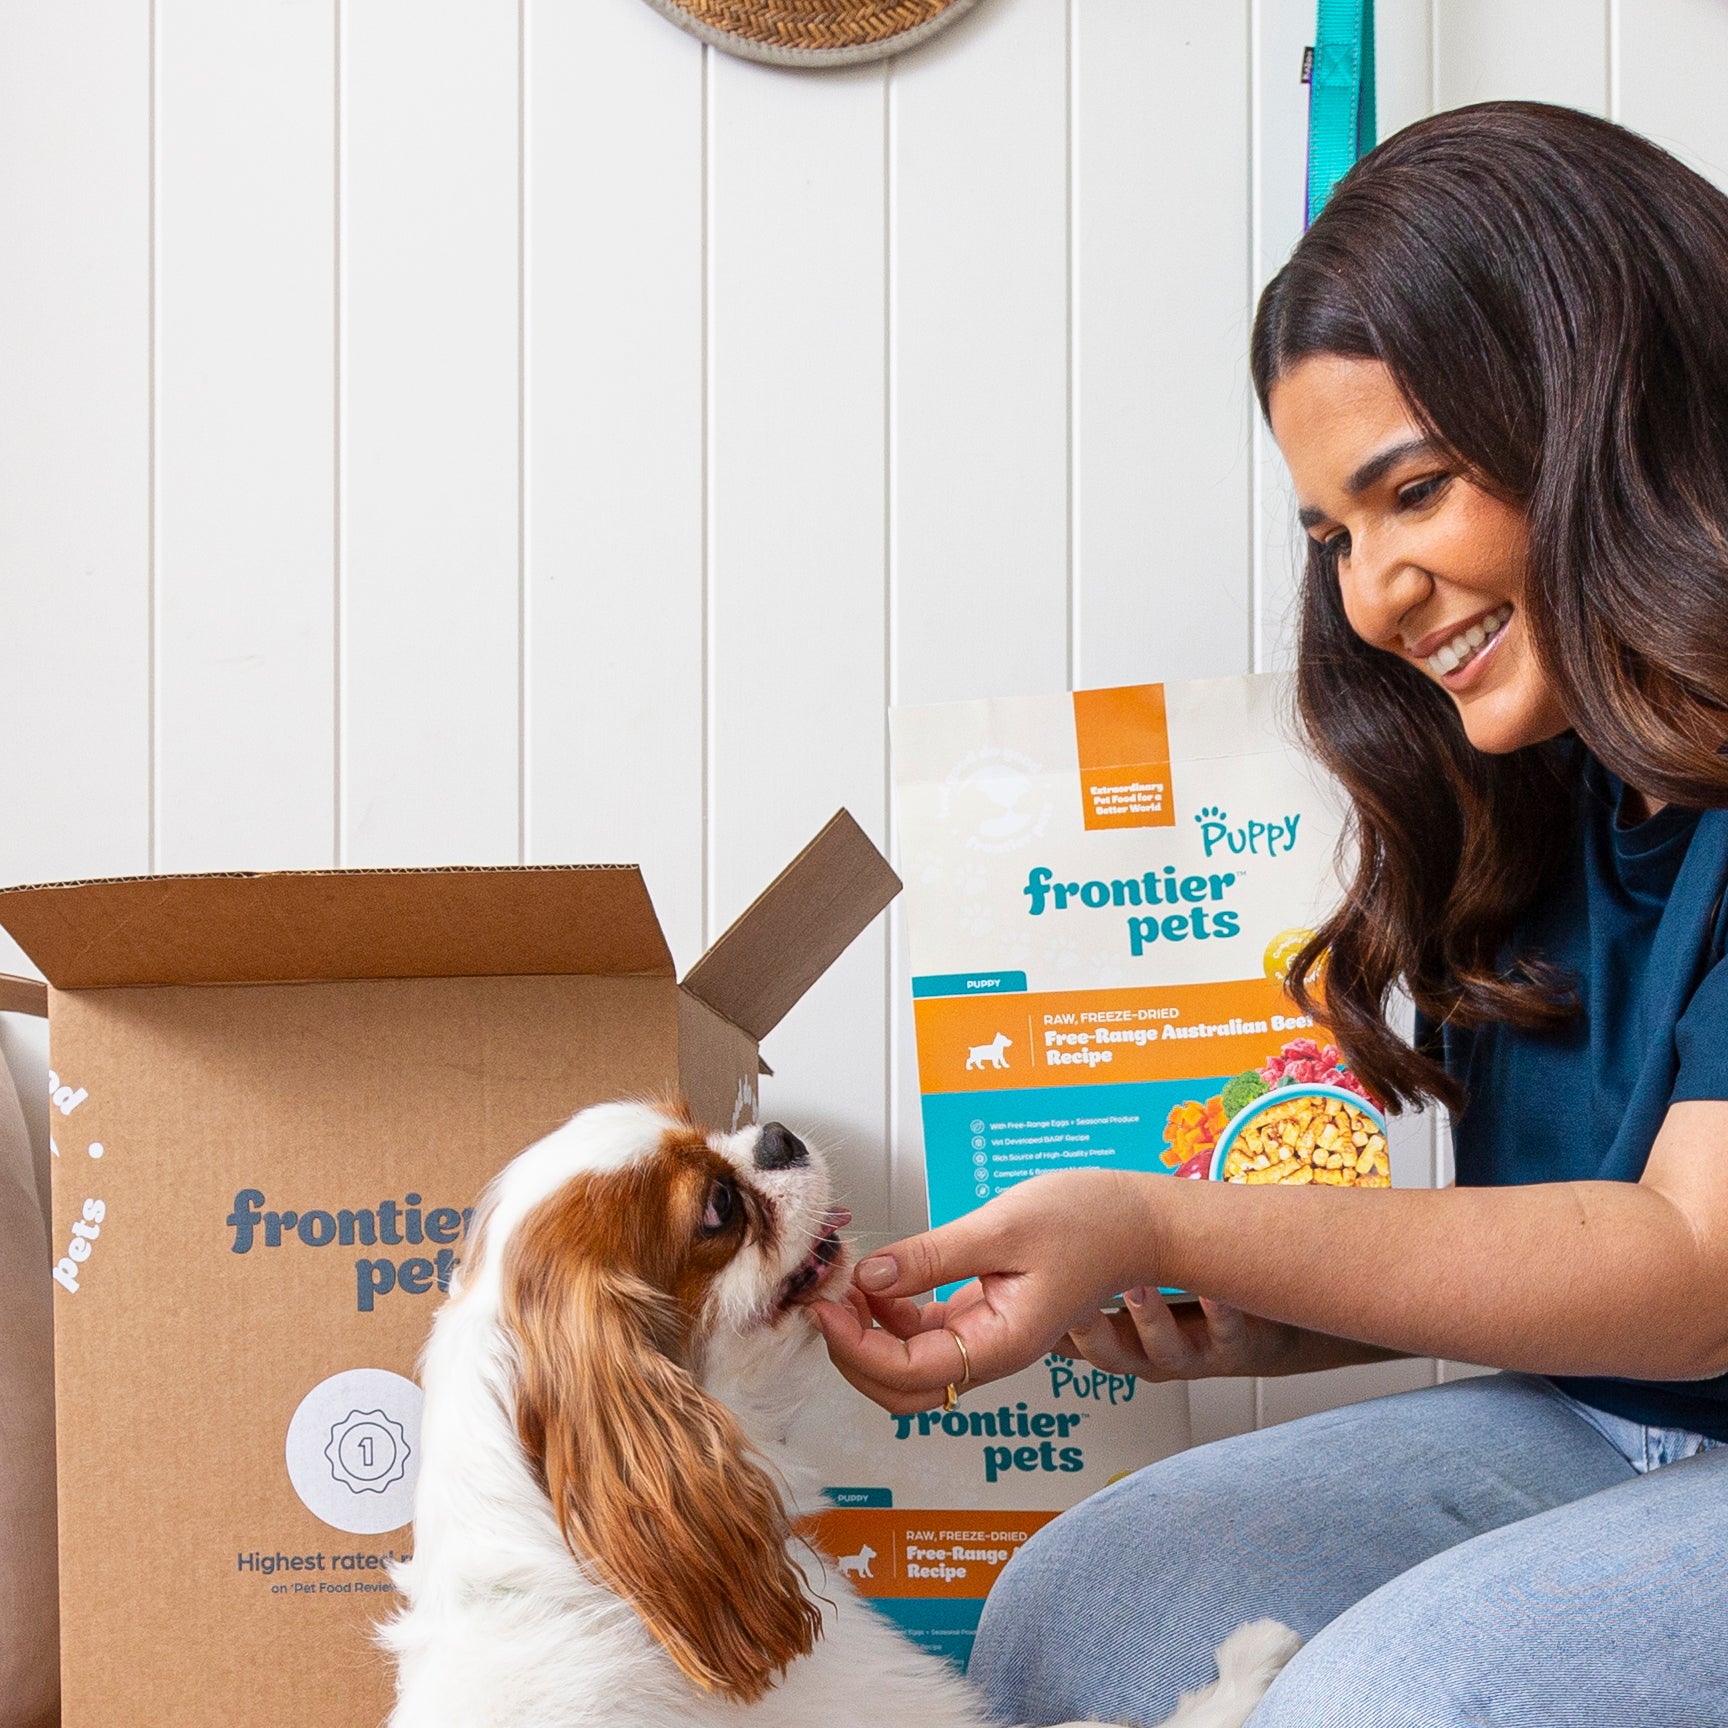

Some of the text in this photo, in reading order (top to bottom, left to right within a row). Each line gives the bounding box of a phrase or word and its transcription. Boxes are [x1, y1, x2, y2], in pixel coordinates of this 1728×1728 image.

[1090, 782, 1163, 795] Extraordinary
[1094, 796, 1110, 805] Pet
[1112, 794, 1136, 804] Food
[1138, 792, 1153, 802] for
[1096, 802, 1161, 816] Better World
[1024, 865, 1235, 916] frontier
[1128, 907, 1240, 957] pets
[967, 979, 1000, 989] PUPPY
[1043, 1007, 1179, 1026] RAW, FREEZE-DRIED
[1045, 1027, 1157, 1048] Free-Range
[1161, 1016, 1268, 1041] Australian
[1046, 1048, 1113, 1068] Recipe
[53, 1198, 106, 1294] pets
[356, 1249, 460, 1312] pet
[983, 1441, 1084, 1483] pets
[838, 1494, 869, 1502] PUPPY
[906, 1530, 1028, 1542] RAW, FREEZE-DRIED
[237, 1552, 325, 1575] Highest
[906, 1546, 1008, 1564] Free-Range
[907, 1563, 967, 1583] Recipe
[271, 1584, 287, 1594] on
[319, 1582, 351, 1593] Food
